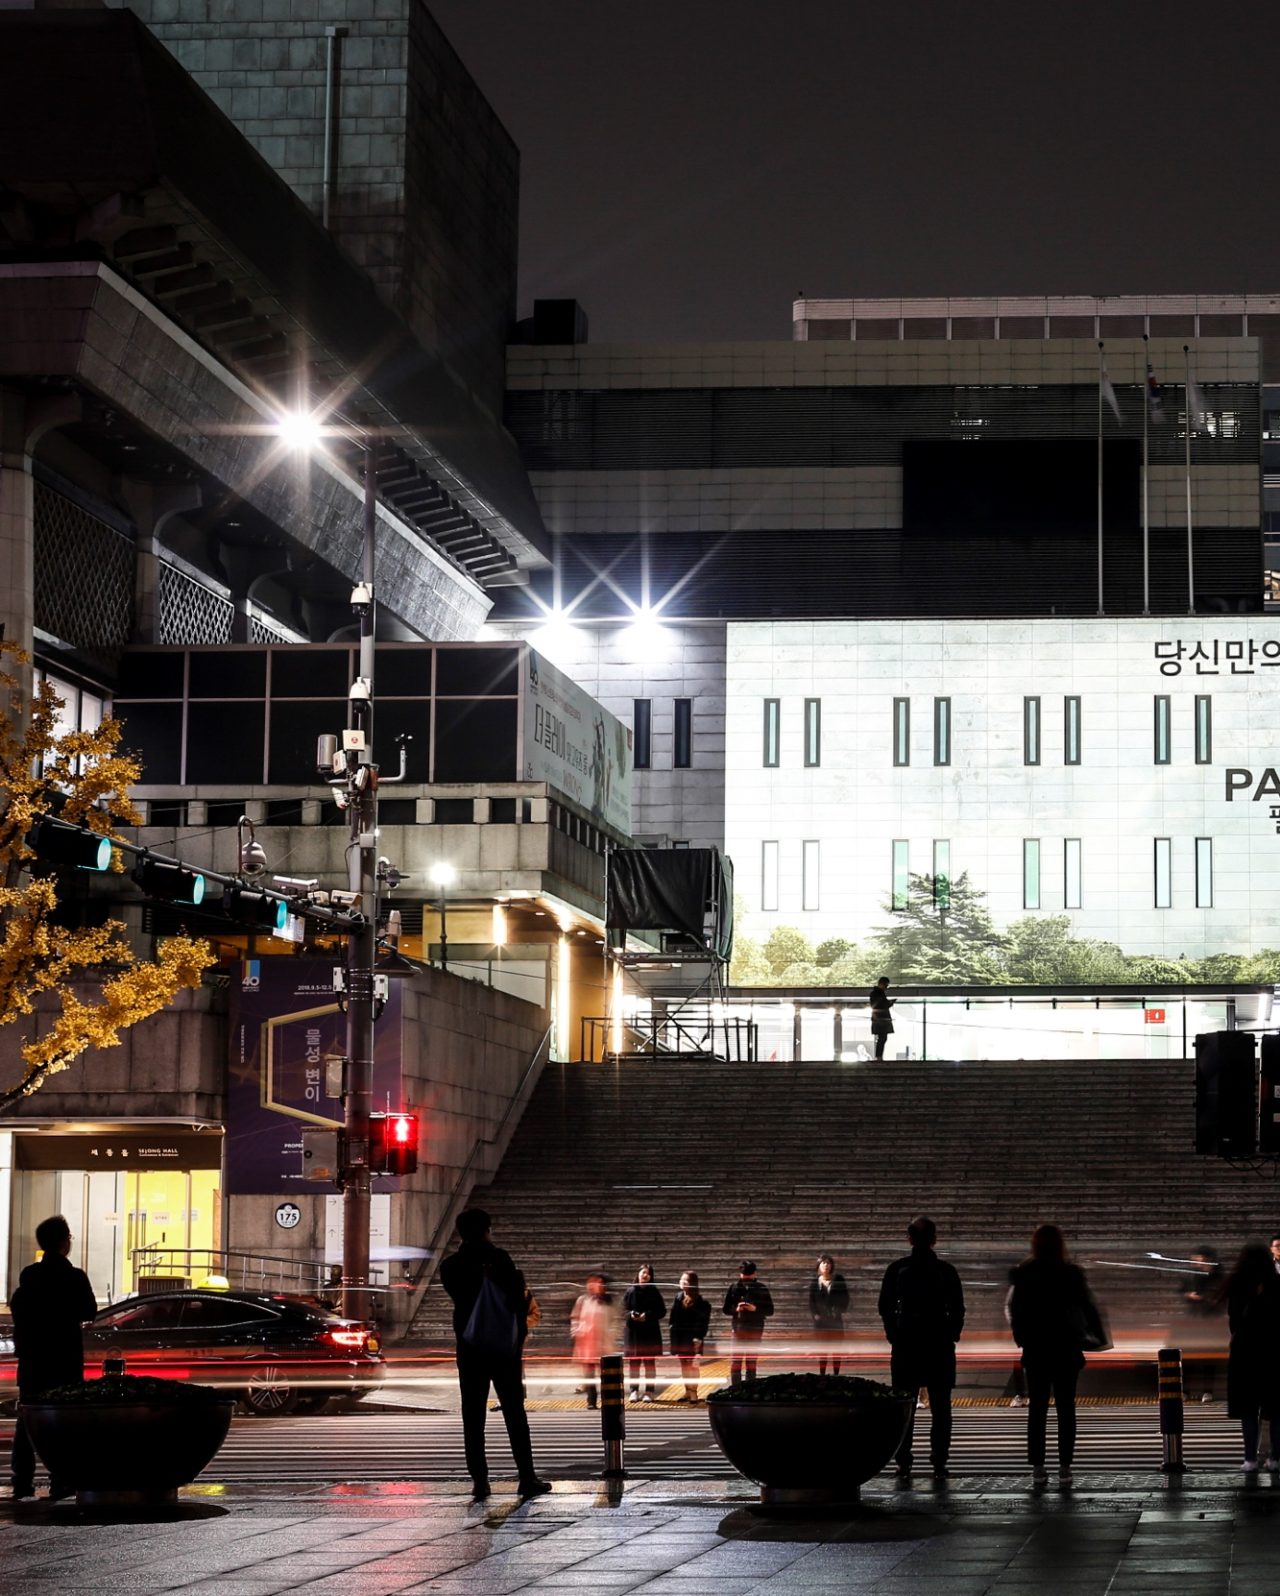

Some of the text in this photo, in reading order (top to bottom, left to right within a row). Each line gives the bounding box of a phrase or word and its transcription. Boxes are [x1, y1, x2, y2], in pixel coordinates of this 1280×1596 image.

[242, 976, 260, 986] 40
[304, 1028, 322, 1103] 물성 변이
[280, 1213, 297, 1221] 175
